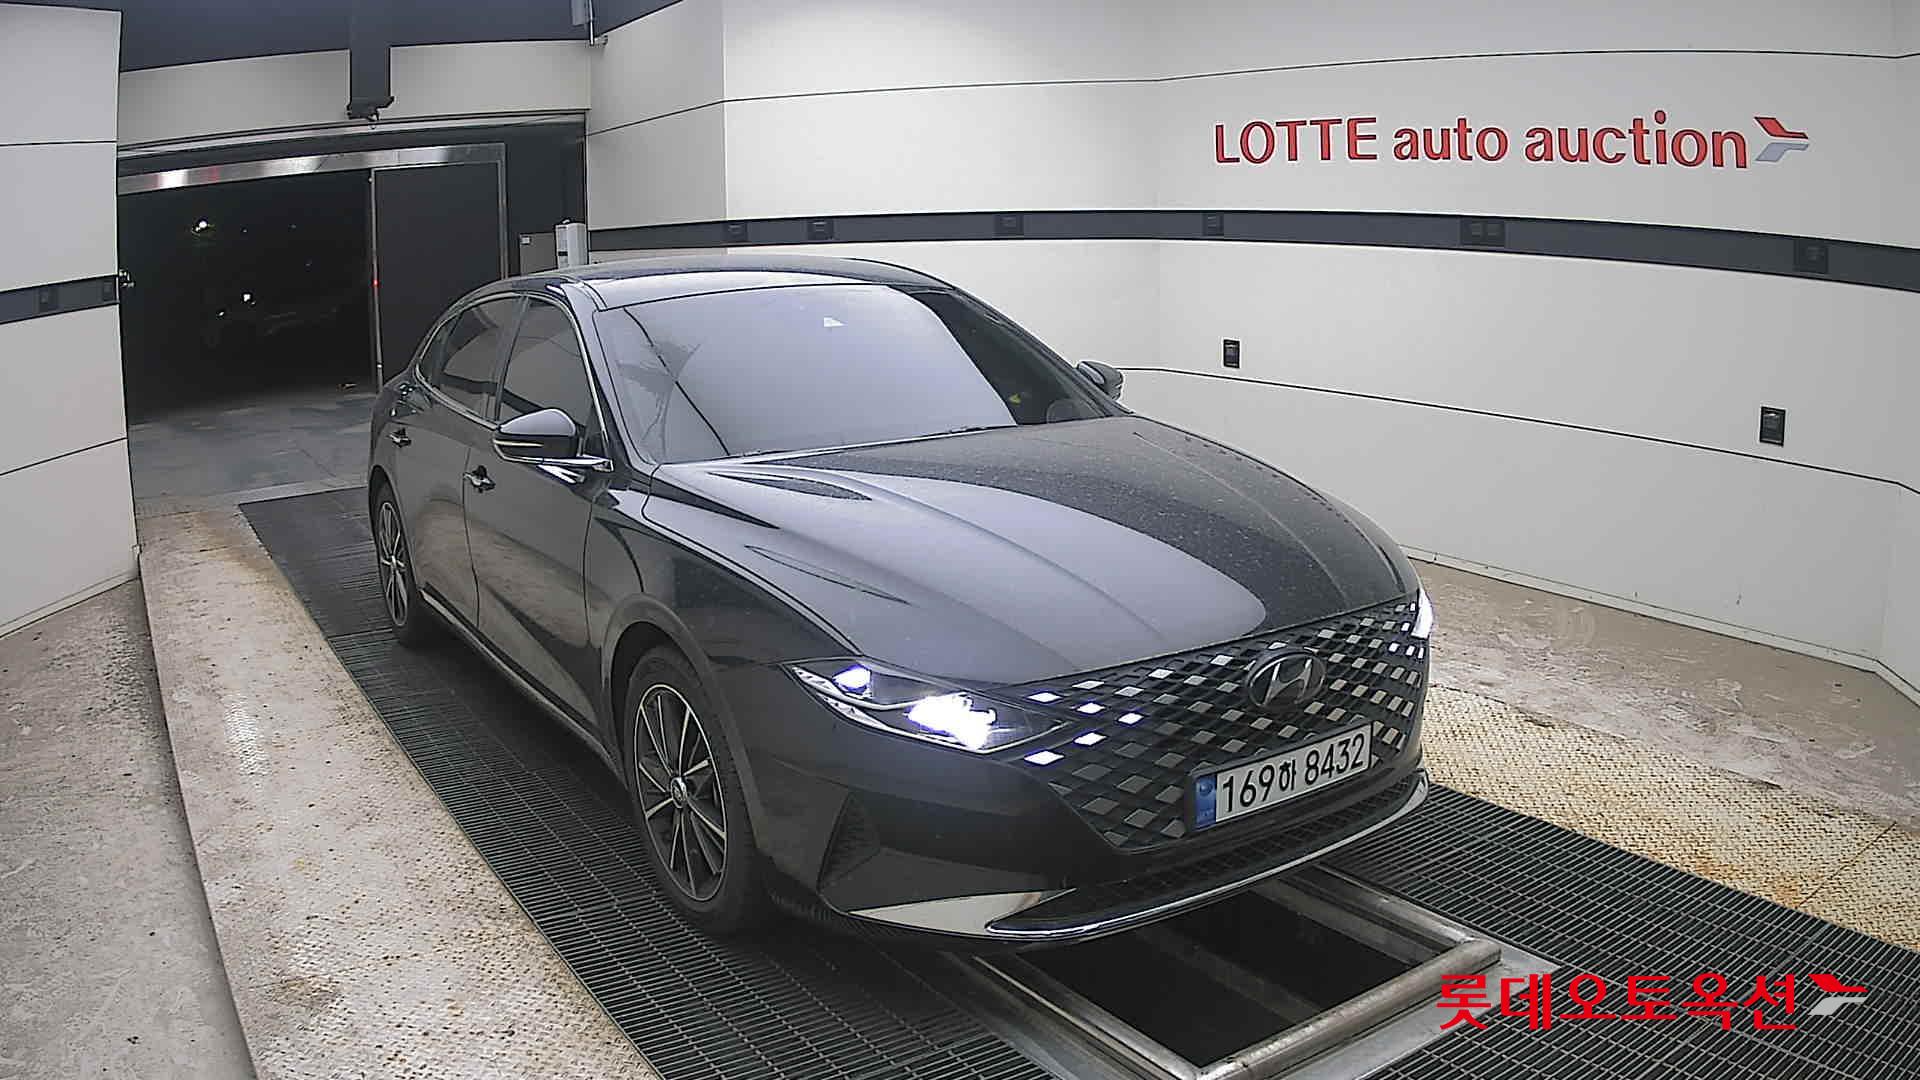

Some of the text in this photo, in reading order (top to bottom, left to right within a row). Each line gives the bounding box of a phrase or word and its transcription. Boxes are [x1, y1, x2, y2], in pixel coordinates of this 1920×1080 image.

[1215, 109, 1748, 169] LOTTE auto auction
[1222, 733, 1365, 813] 169하 8432
